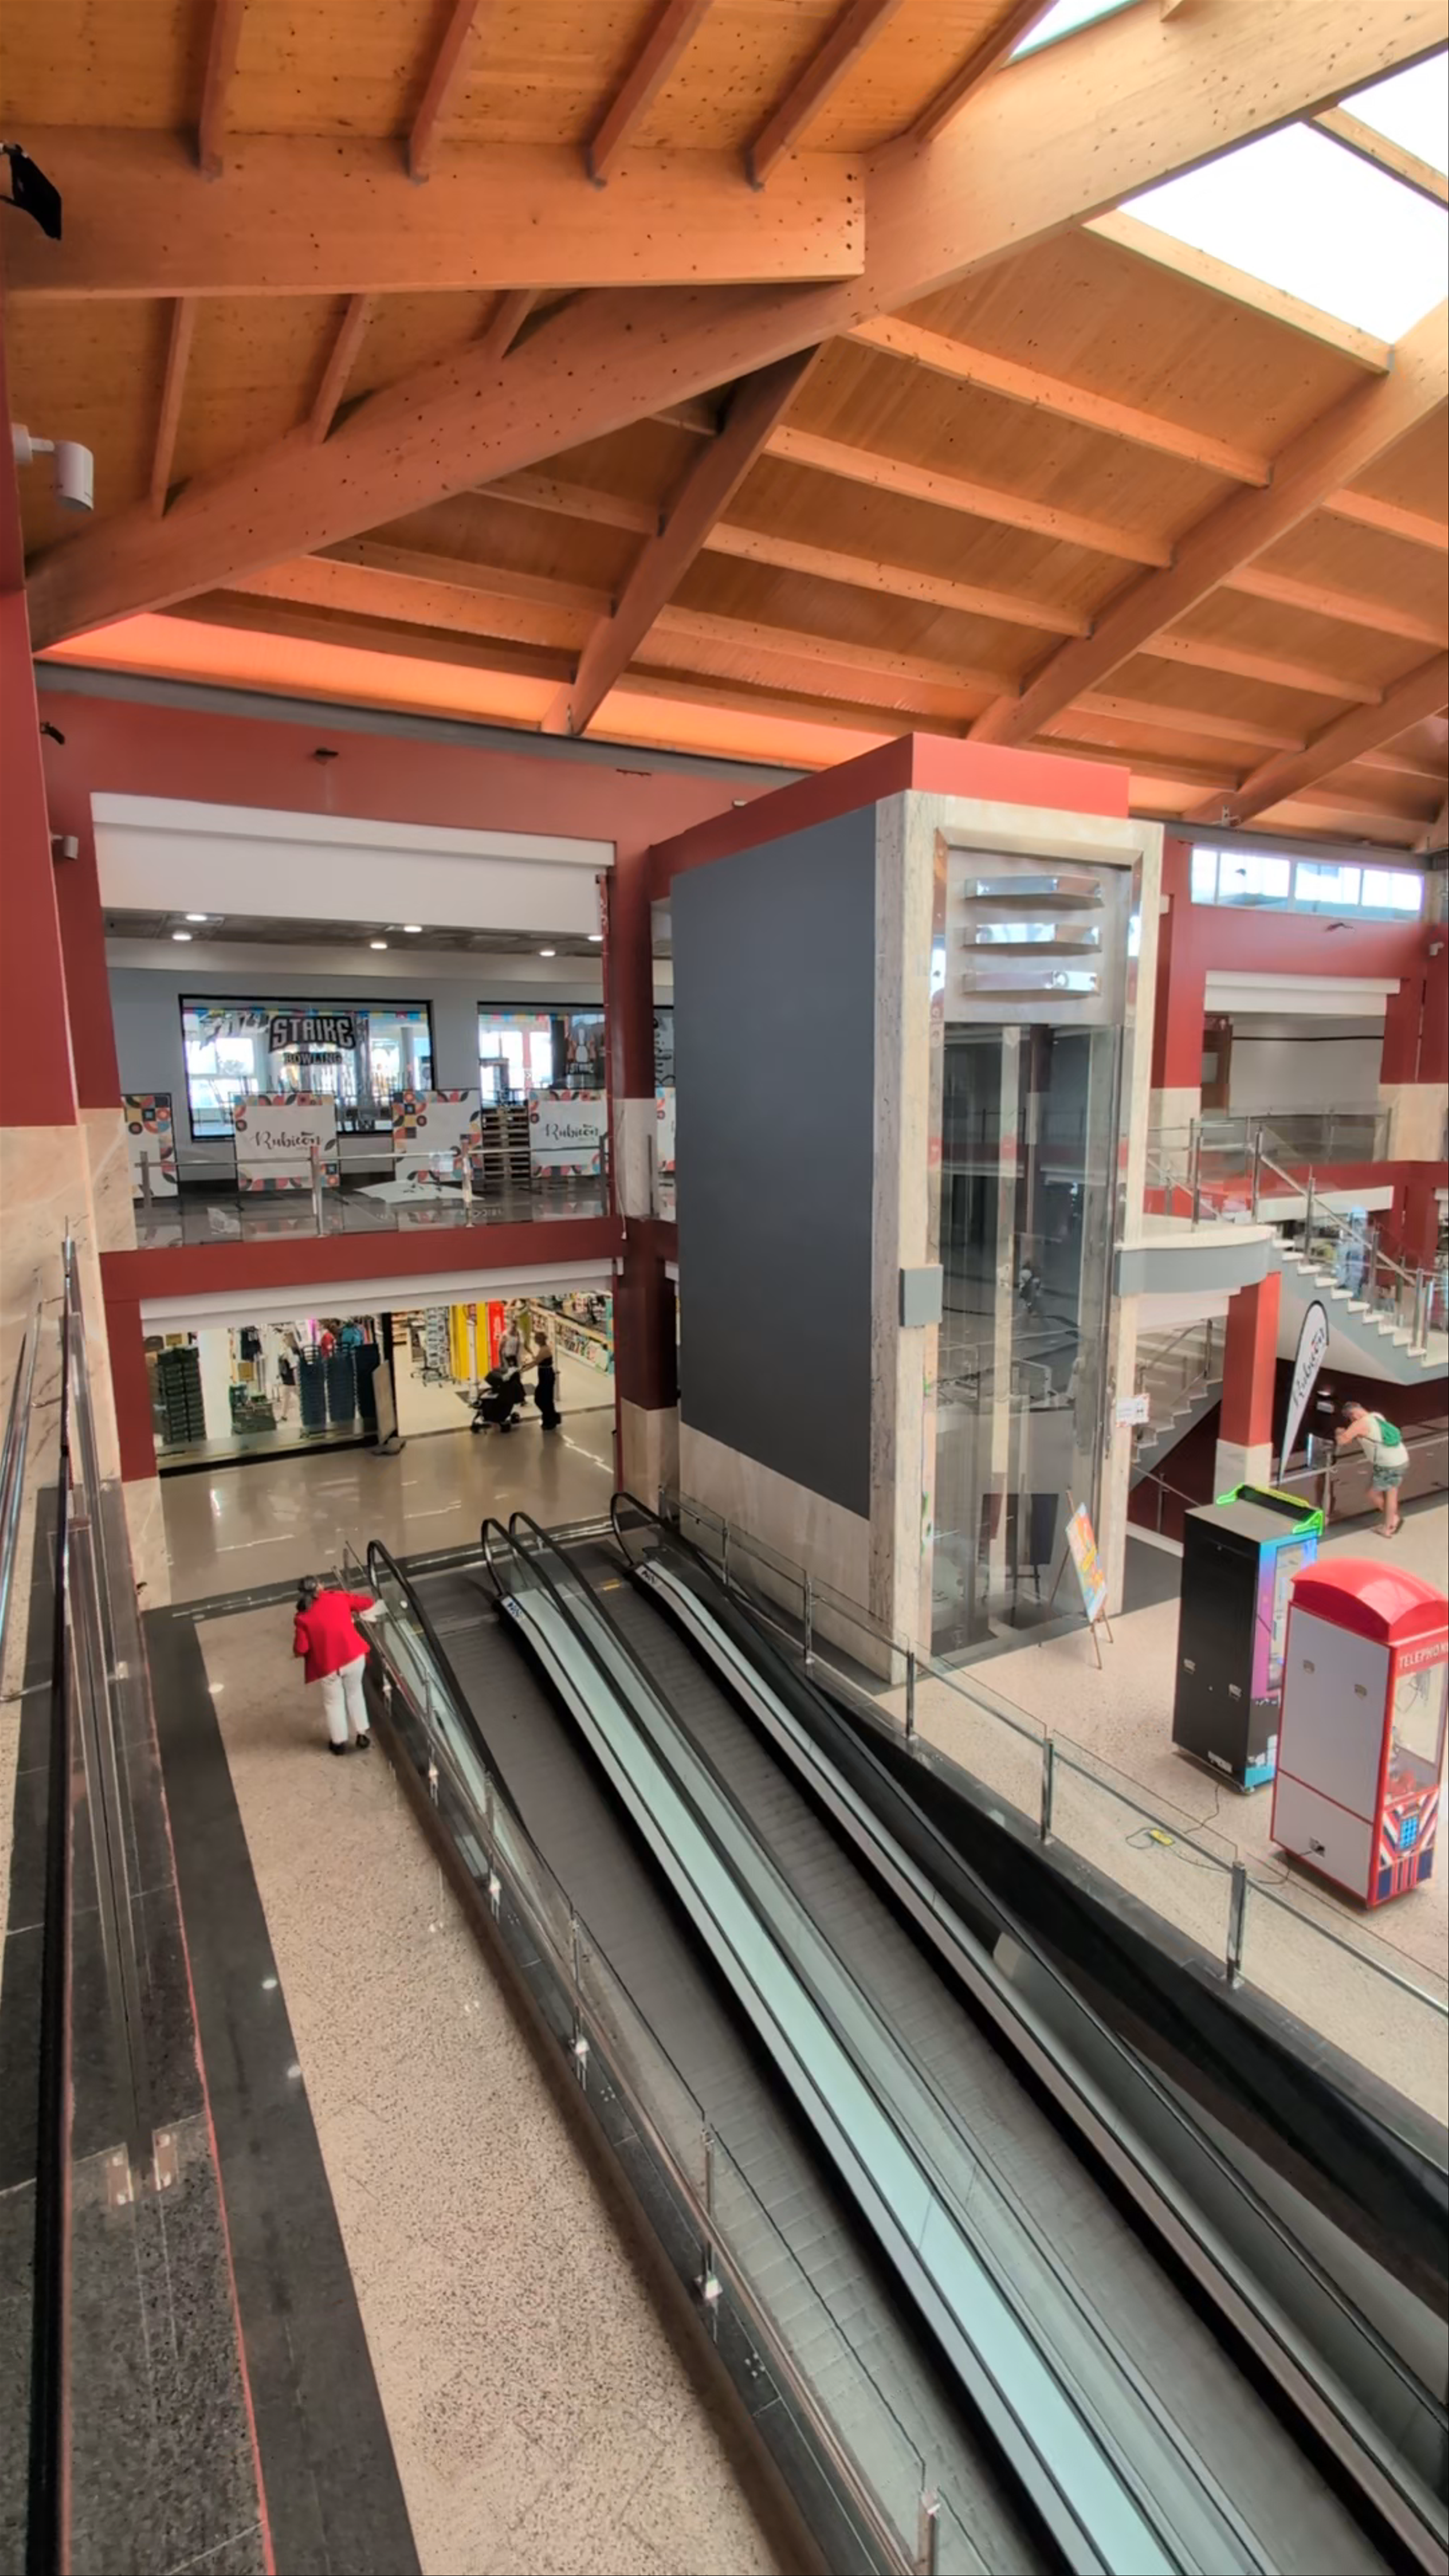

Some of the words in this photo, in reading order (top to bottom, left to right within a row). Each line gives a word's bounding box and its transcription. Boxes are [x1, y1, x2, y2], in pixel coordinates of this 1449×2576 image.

[272, 1018, 354, 1049] STRIKE
[284, 1052, 343, 1065] BOWLING
[1400, 1641, 1448, 1669] TELEPHON
